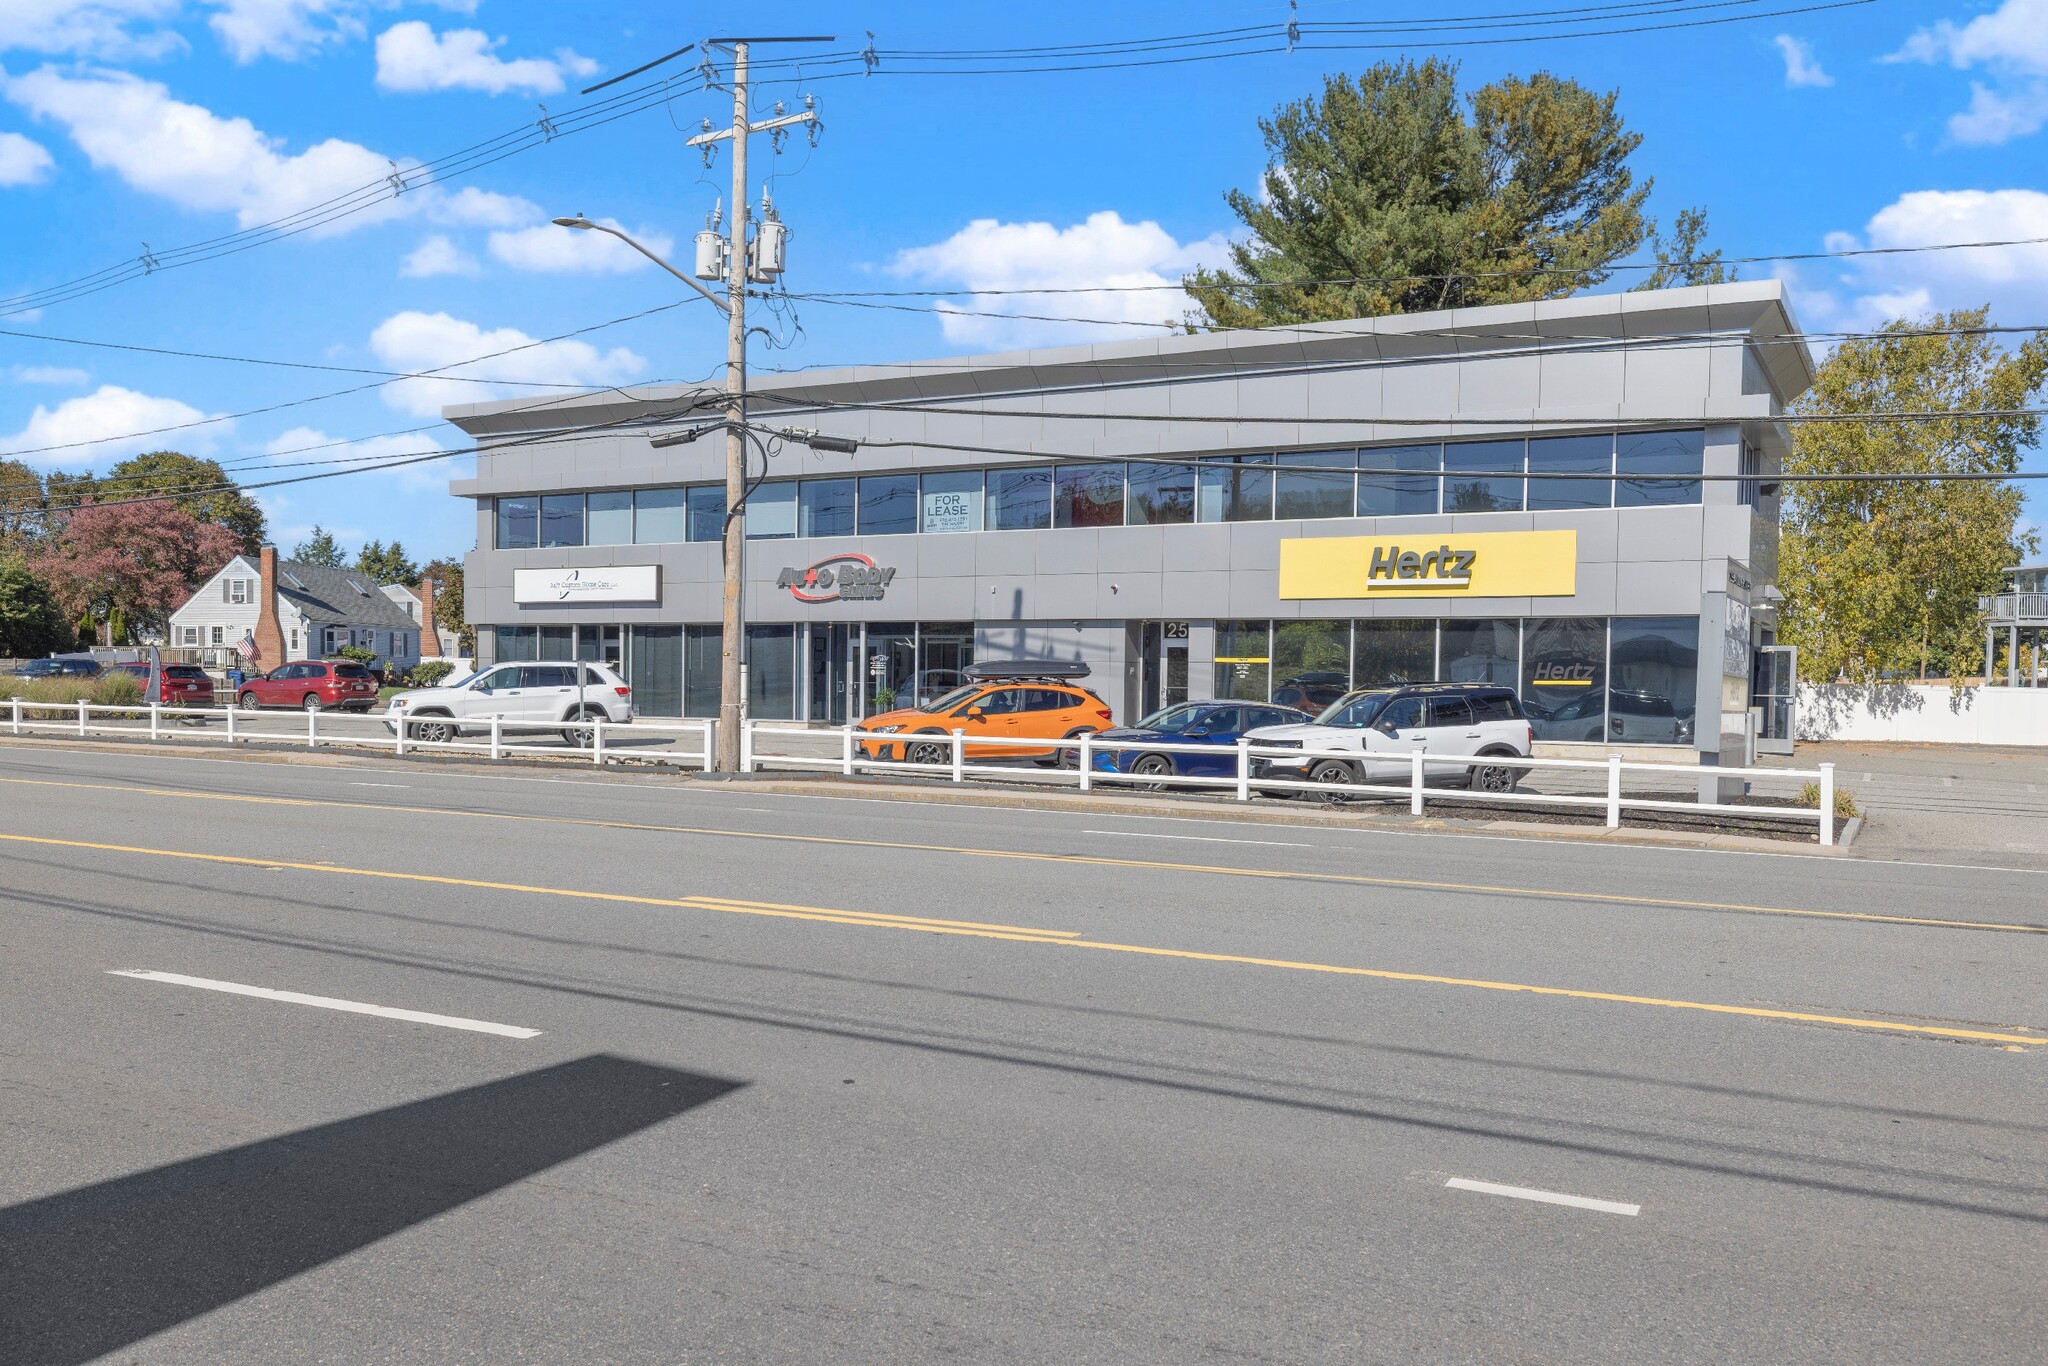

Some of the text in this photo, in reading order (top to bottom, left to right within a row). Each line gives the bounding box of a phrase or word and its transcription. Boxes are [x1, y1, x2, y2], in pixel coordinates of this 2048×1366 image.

[935, 495, 960, 505] FOR
[927, 505, 968, 516] LEASE
[1368, 545, 1476, 579] Hertz
[840, 585, 884, 600] CLINIC
[1167, 622, 1188, 638] 25
[1534, 662, 1596, 680] Hertz
